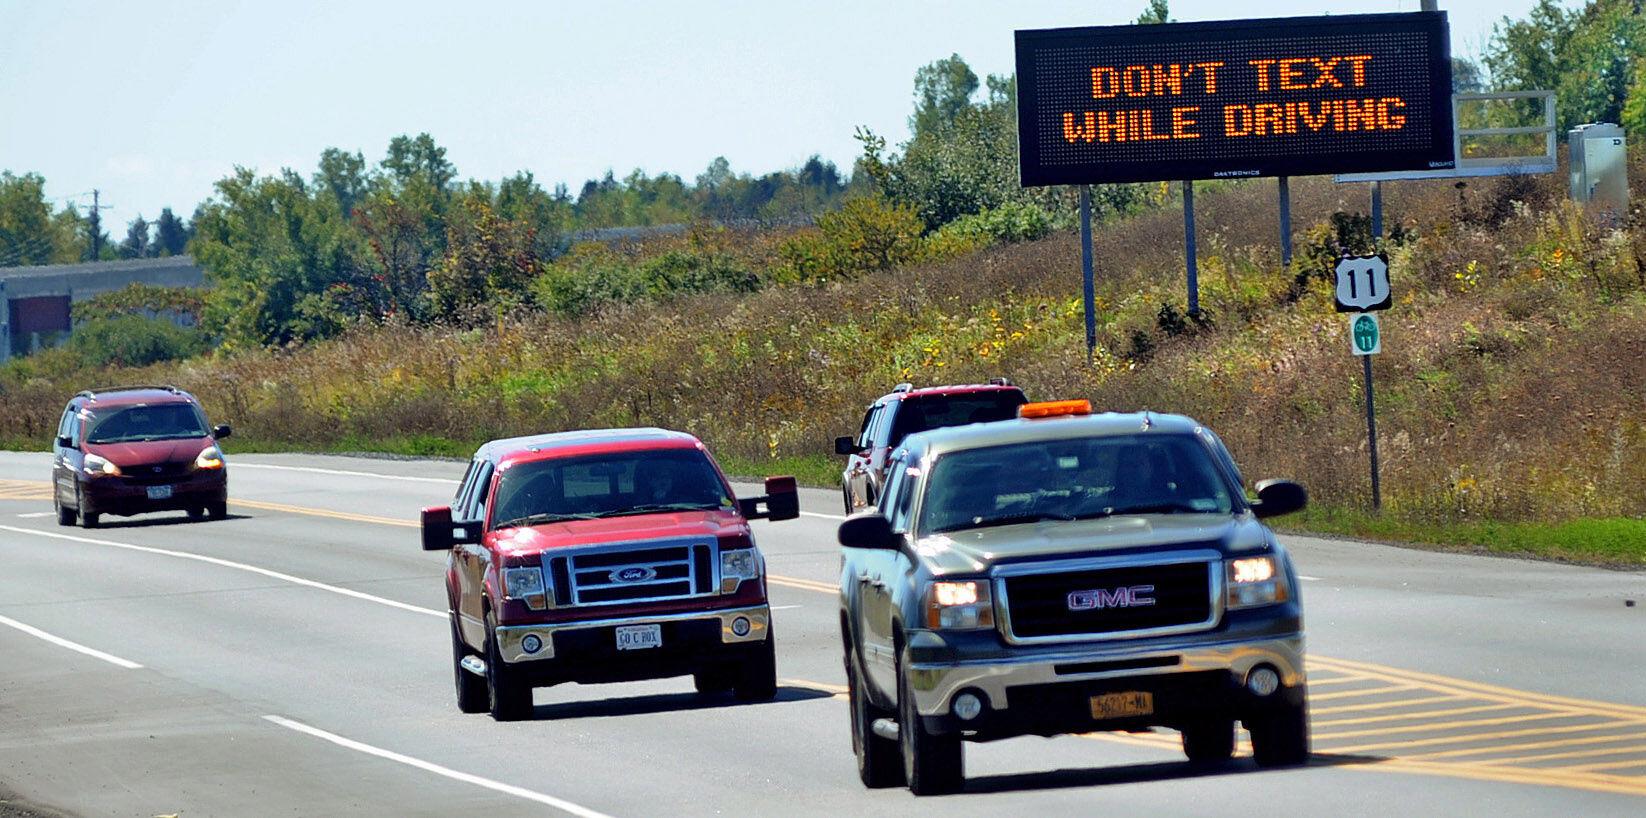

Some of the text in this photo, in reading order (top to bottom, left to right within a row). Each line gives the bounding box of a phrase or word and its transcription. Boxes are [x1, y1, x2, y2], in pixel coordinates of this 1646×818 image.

[1091, 55, 1372, 99] DON'T TEXT
[1063, 97, 1406, 143] WHILE DRIVING
[1347, 268, 1376, 299] 11
[1361, 336, 1373, 350] 11
[1067, 584, 1156, 611] GMC
